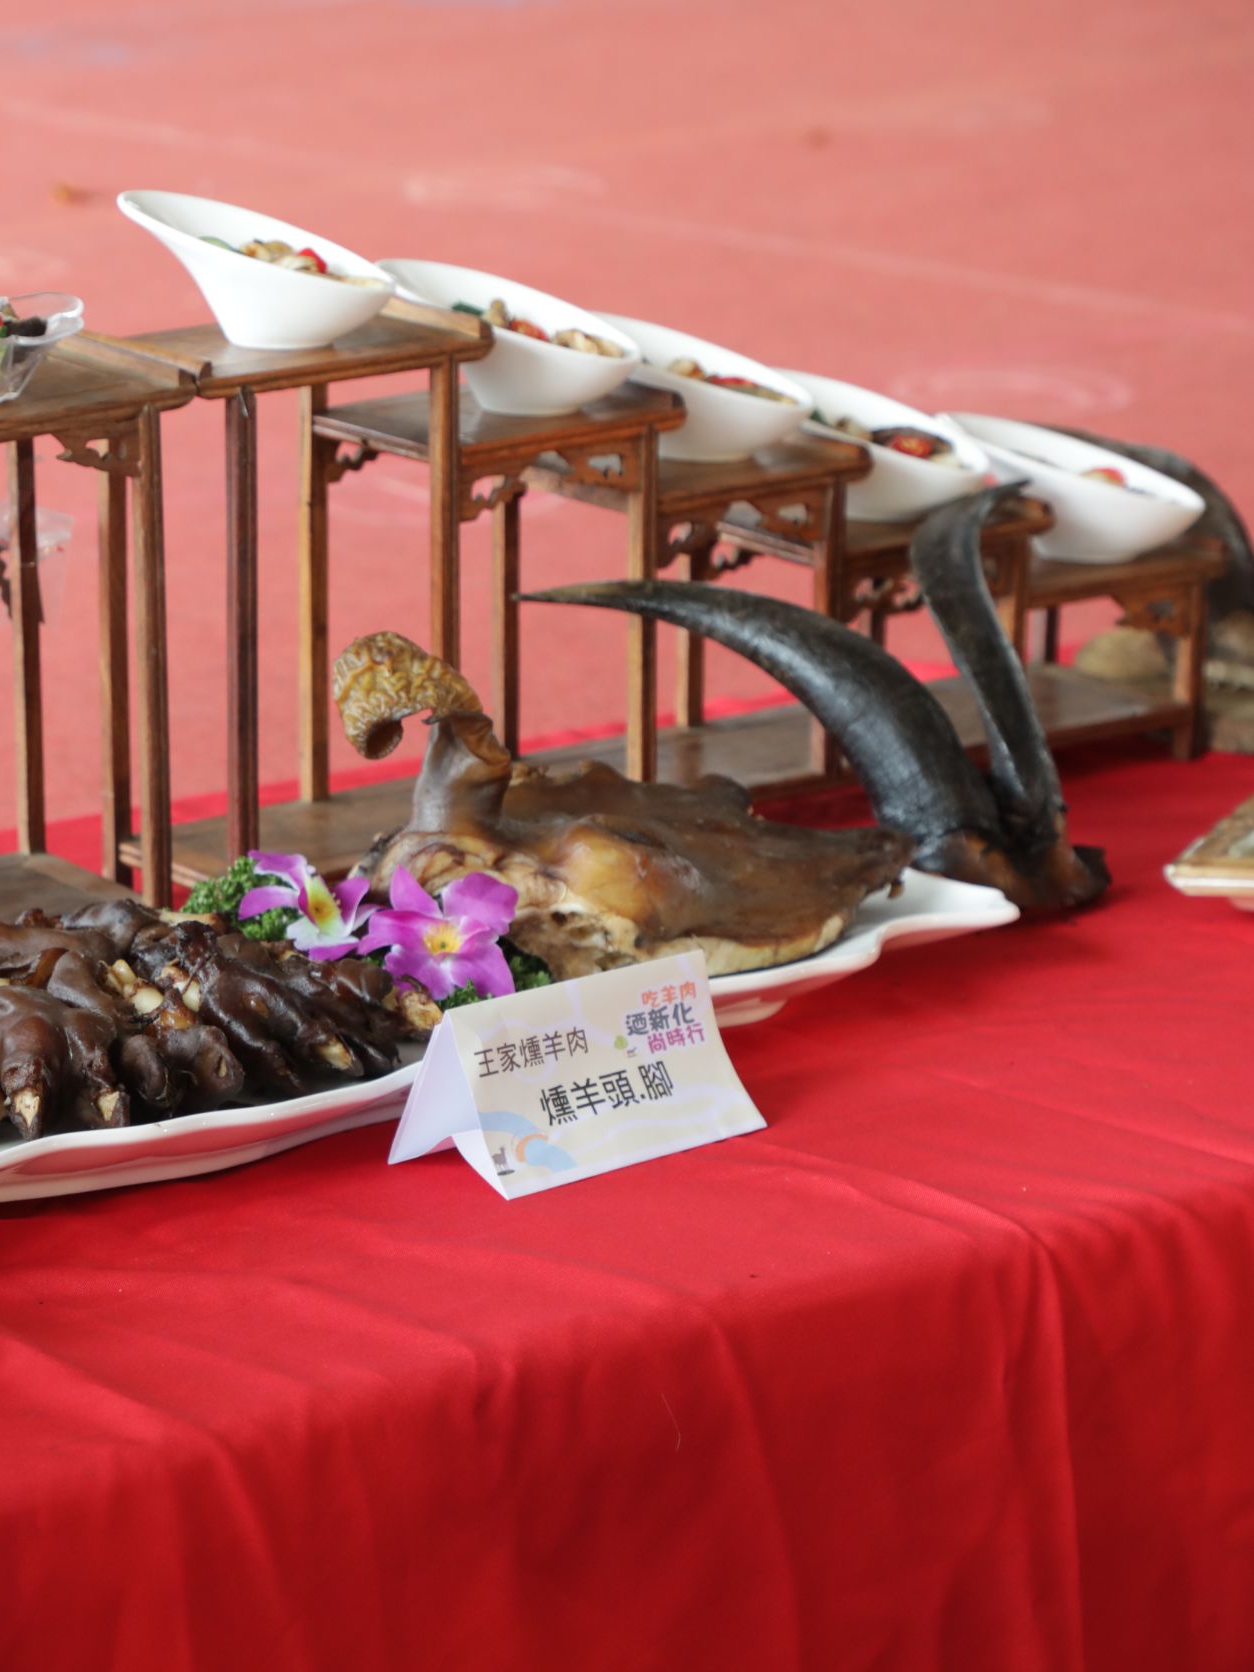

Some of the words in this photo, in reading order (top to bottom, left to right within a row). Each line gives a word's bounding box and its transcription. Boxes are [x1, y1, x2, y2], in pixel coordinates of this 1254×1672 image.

[642, 981, 696, 1008] 吃羊肉
[474, 1026, 589, 1078] 王家燻羊肉
[648, 1023, 705, 1054] 尚時行
